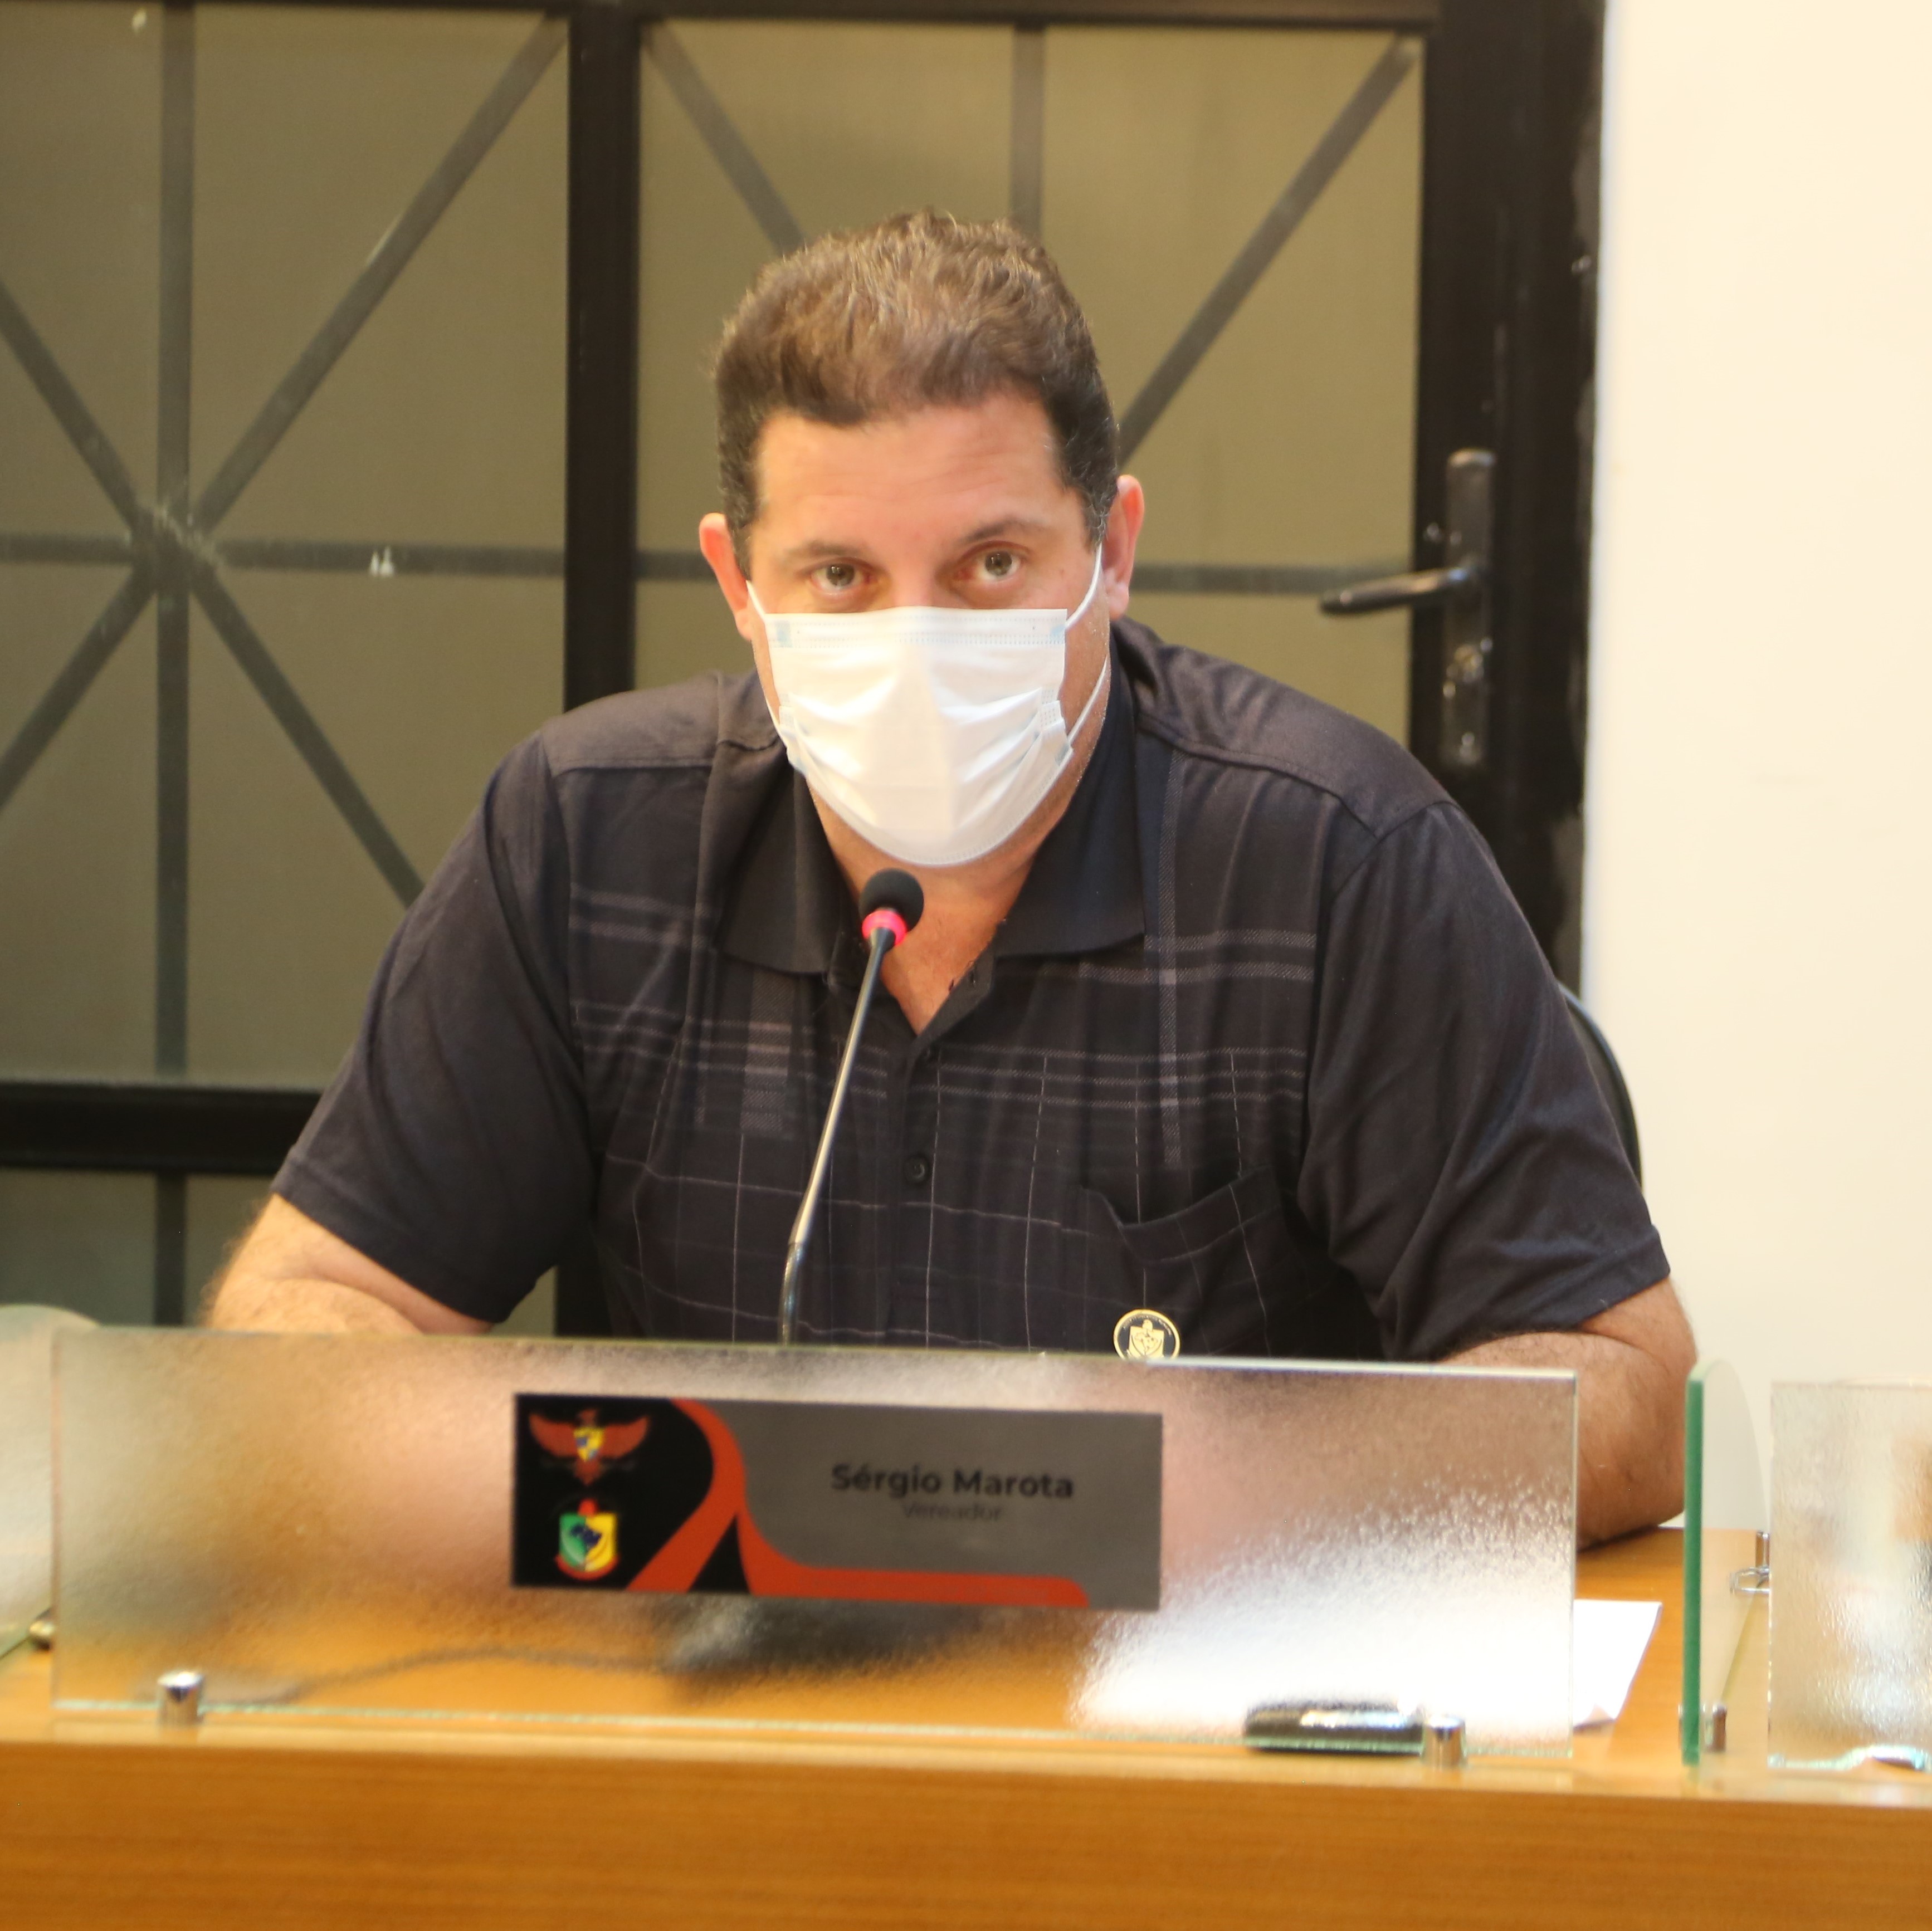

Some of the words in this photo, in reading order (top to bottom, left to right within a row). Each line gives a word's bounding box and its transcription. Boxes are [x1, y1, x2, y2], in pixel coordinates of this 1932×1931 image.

[831, 1463, 942, 1499] Sérgio
[953, 1469, 1075, 1499] Marota
[903, 1502, 1002, 1521] Vereador
